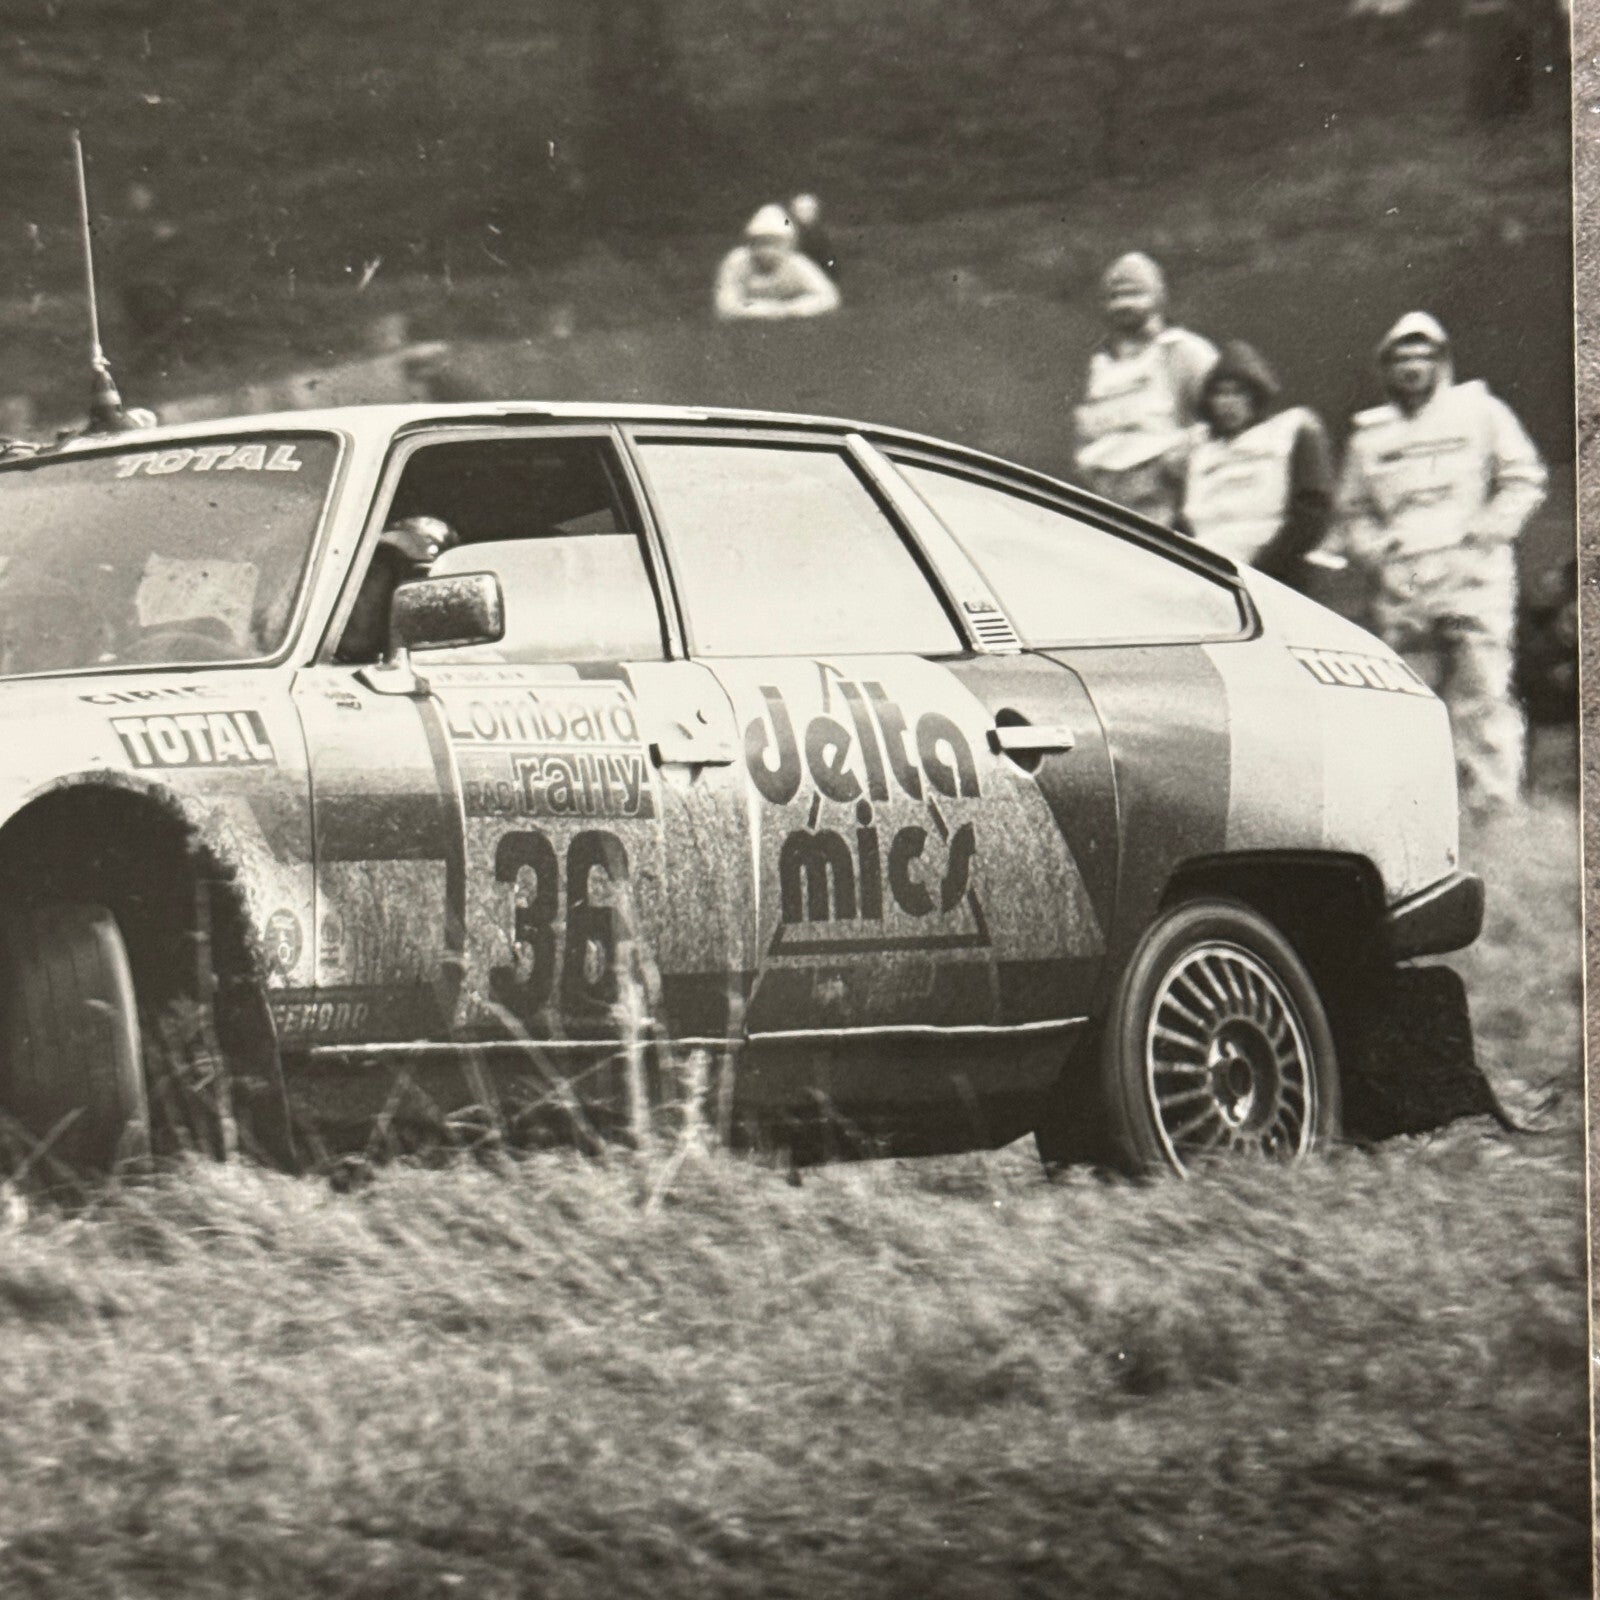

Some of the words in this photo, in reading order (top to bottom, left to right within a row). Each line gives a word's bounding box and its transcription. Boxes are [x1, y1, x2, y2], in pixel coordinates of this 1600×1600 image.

[116, 445, 302, 478] TOTAL
[1288, 646, 1434, 698] TOTAL
[111, 712, 274, 766] TOTAL
[448, 690, 639, 742] Lombard
[745, 681, 981, 805] delta
[513, 755, 643, 817] rally
[778, 800, 976, 923] mics
[488, 829, 628, 1018] 36
